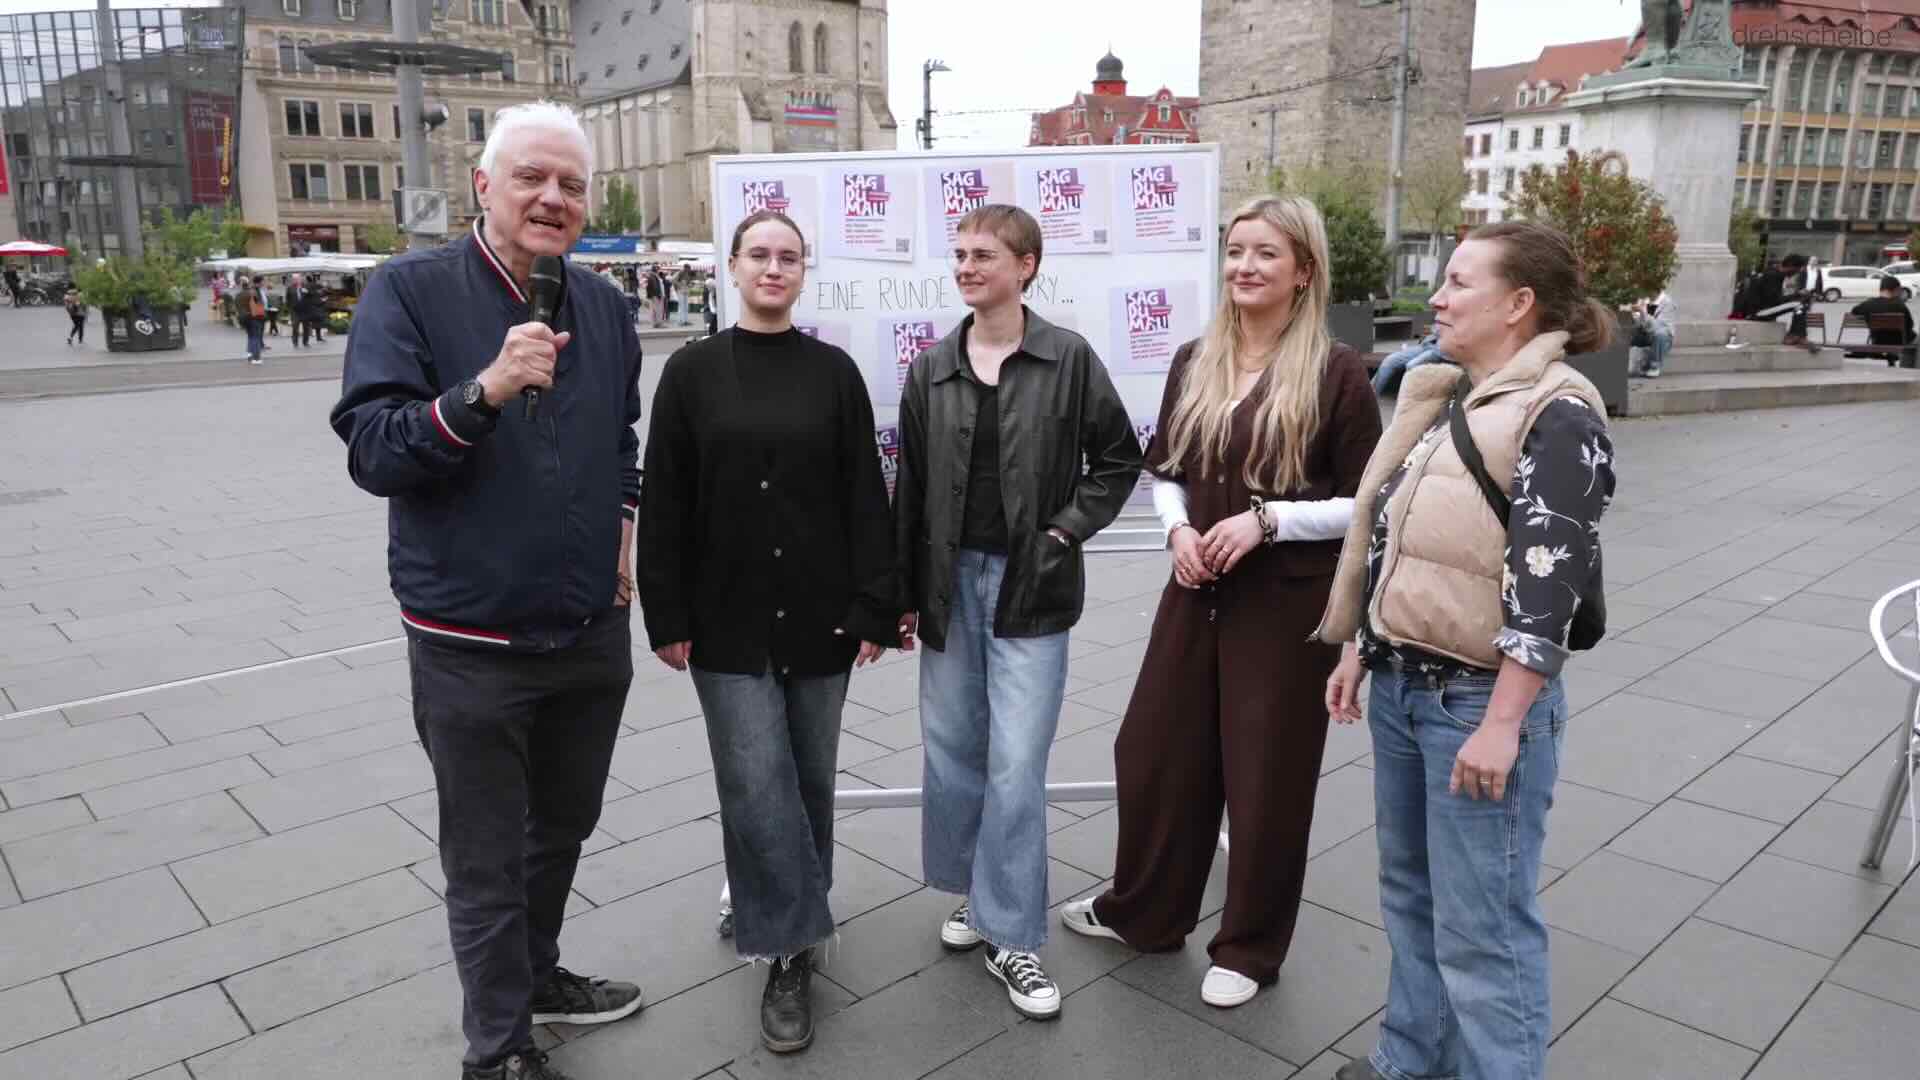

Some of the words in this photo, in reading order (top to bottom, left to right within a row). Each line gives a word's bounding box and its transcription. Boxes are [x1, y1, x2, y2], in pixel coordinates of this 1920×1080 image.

[845, 174, 877, 189] SAG
[942, 171, 975, 186] SAG
[1039, 169, 1071, 185] SAG
[1133, 167, 1165, 182] SAG
[744, 181, 777, 197] SAG
[847, 187, 866, 202] DU
[944, 184, 966, 200] DU
[1040, 184, 1062, 199] DU
[1135, 180, 1156, 196] DU
[746, 194, 767, 210] DU
[816, 280, 865, 311] EINE
[879, 276, 953, 311] RUNDE
[1127, 290, 1159, 306] SAG
[1128, 303, 1150, 319] DU
[895, 323, 927, 338] SAG
[896, 335, 918, 352] DU
